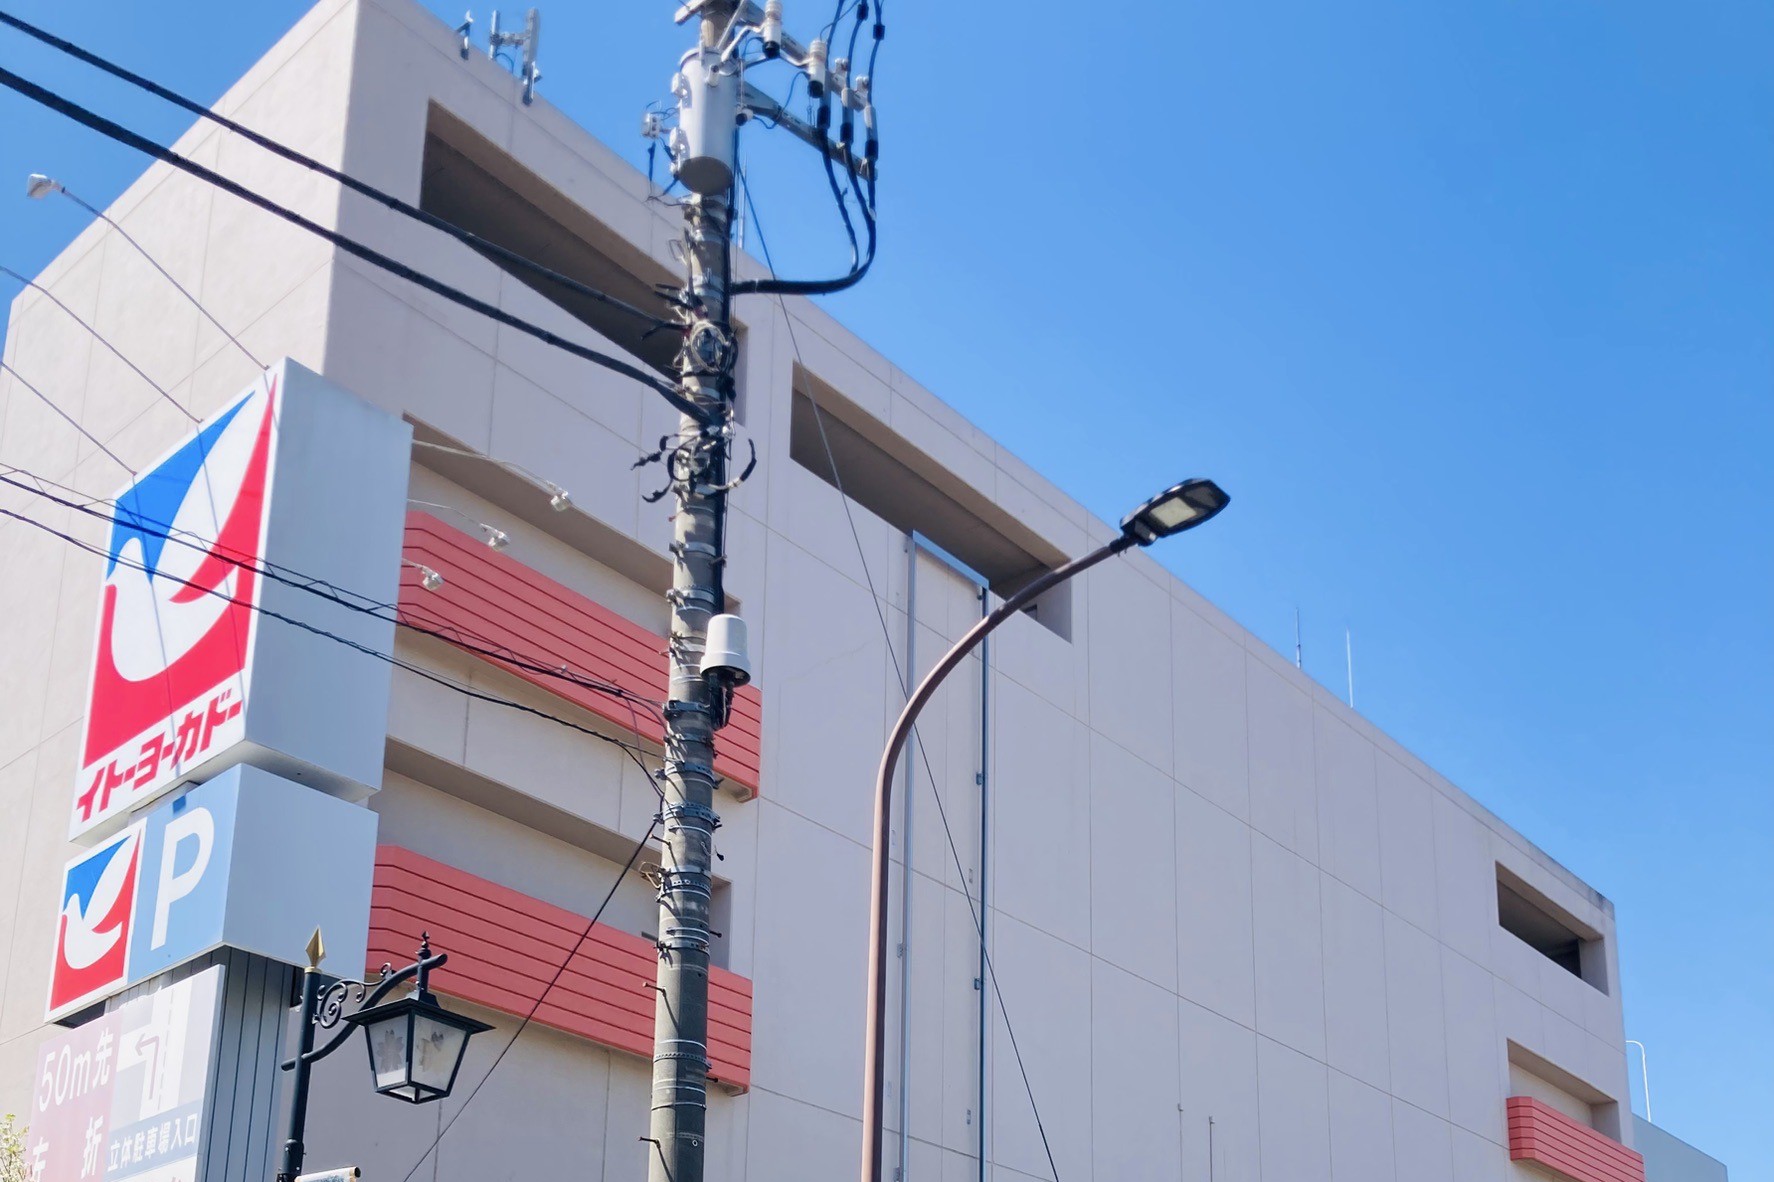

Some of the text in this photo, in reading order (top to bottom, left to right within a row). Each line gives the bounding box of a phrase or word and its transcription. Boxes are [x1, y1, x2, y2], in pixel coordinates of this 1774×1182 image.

[77, 688, 242, 822] イトーヨーカドー
[151, 806, 216, 950] P
[38, 1026, 114, 1112] 50m先
[107, 1112, 199, 1173] 立体駐車場入口
